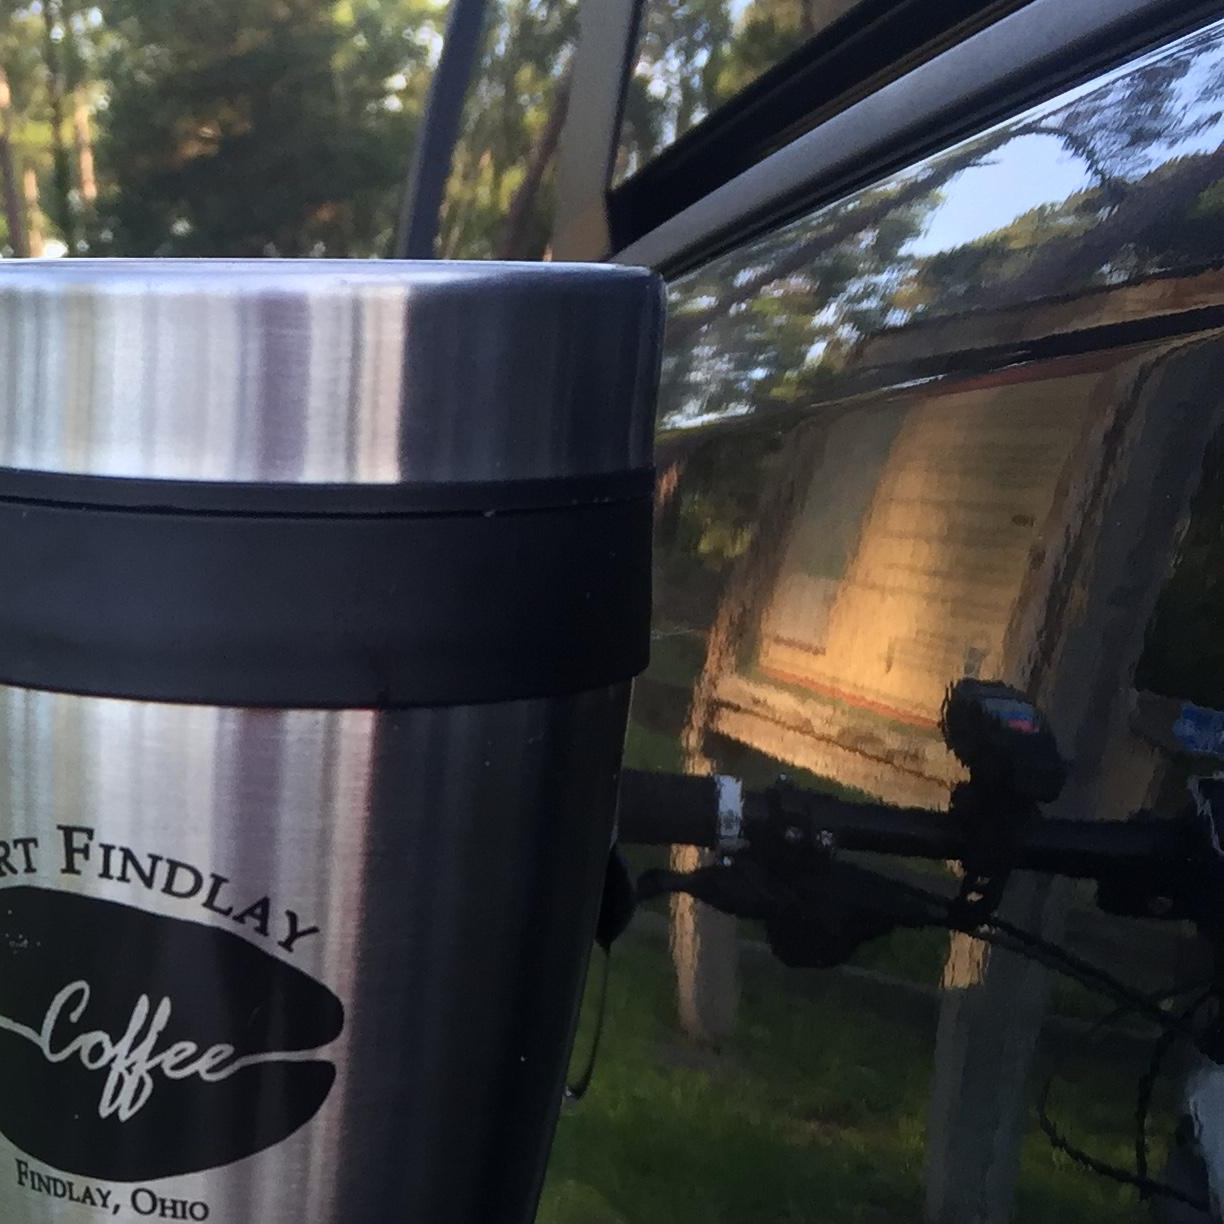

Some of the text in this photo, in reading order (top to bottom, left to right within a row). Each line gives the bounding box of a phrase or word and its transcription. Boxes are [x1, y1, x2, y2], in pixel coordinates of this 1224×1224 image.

[57, 824, 320, 953] FINDLAY
[40, 979, 241, 1122] Coffee
[130, 1187, 210, 1221] OHIO
